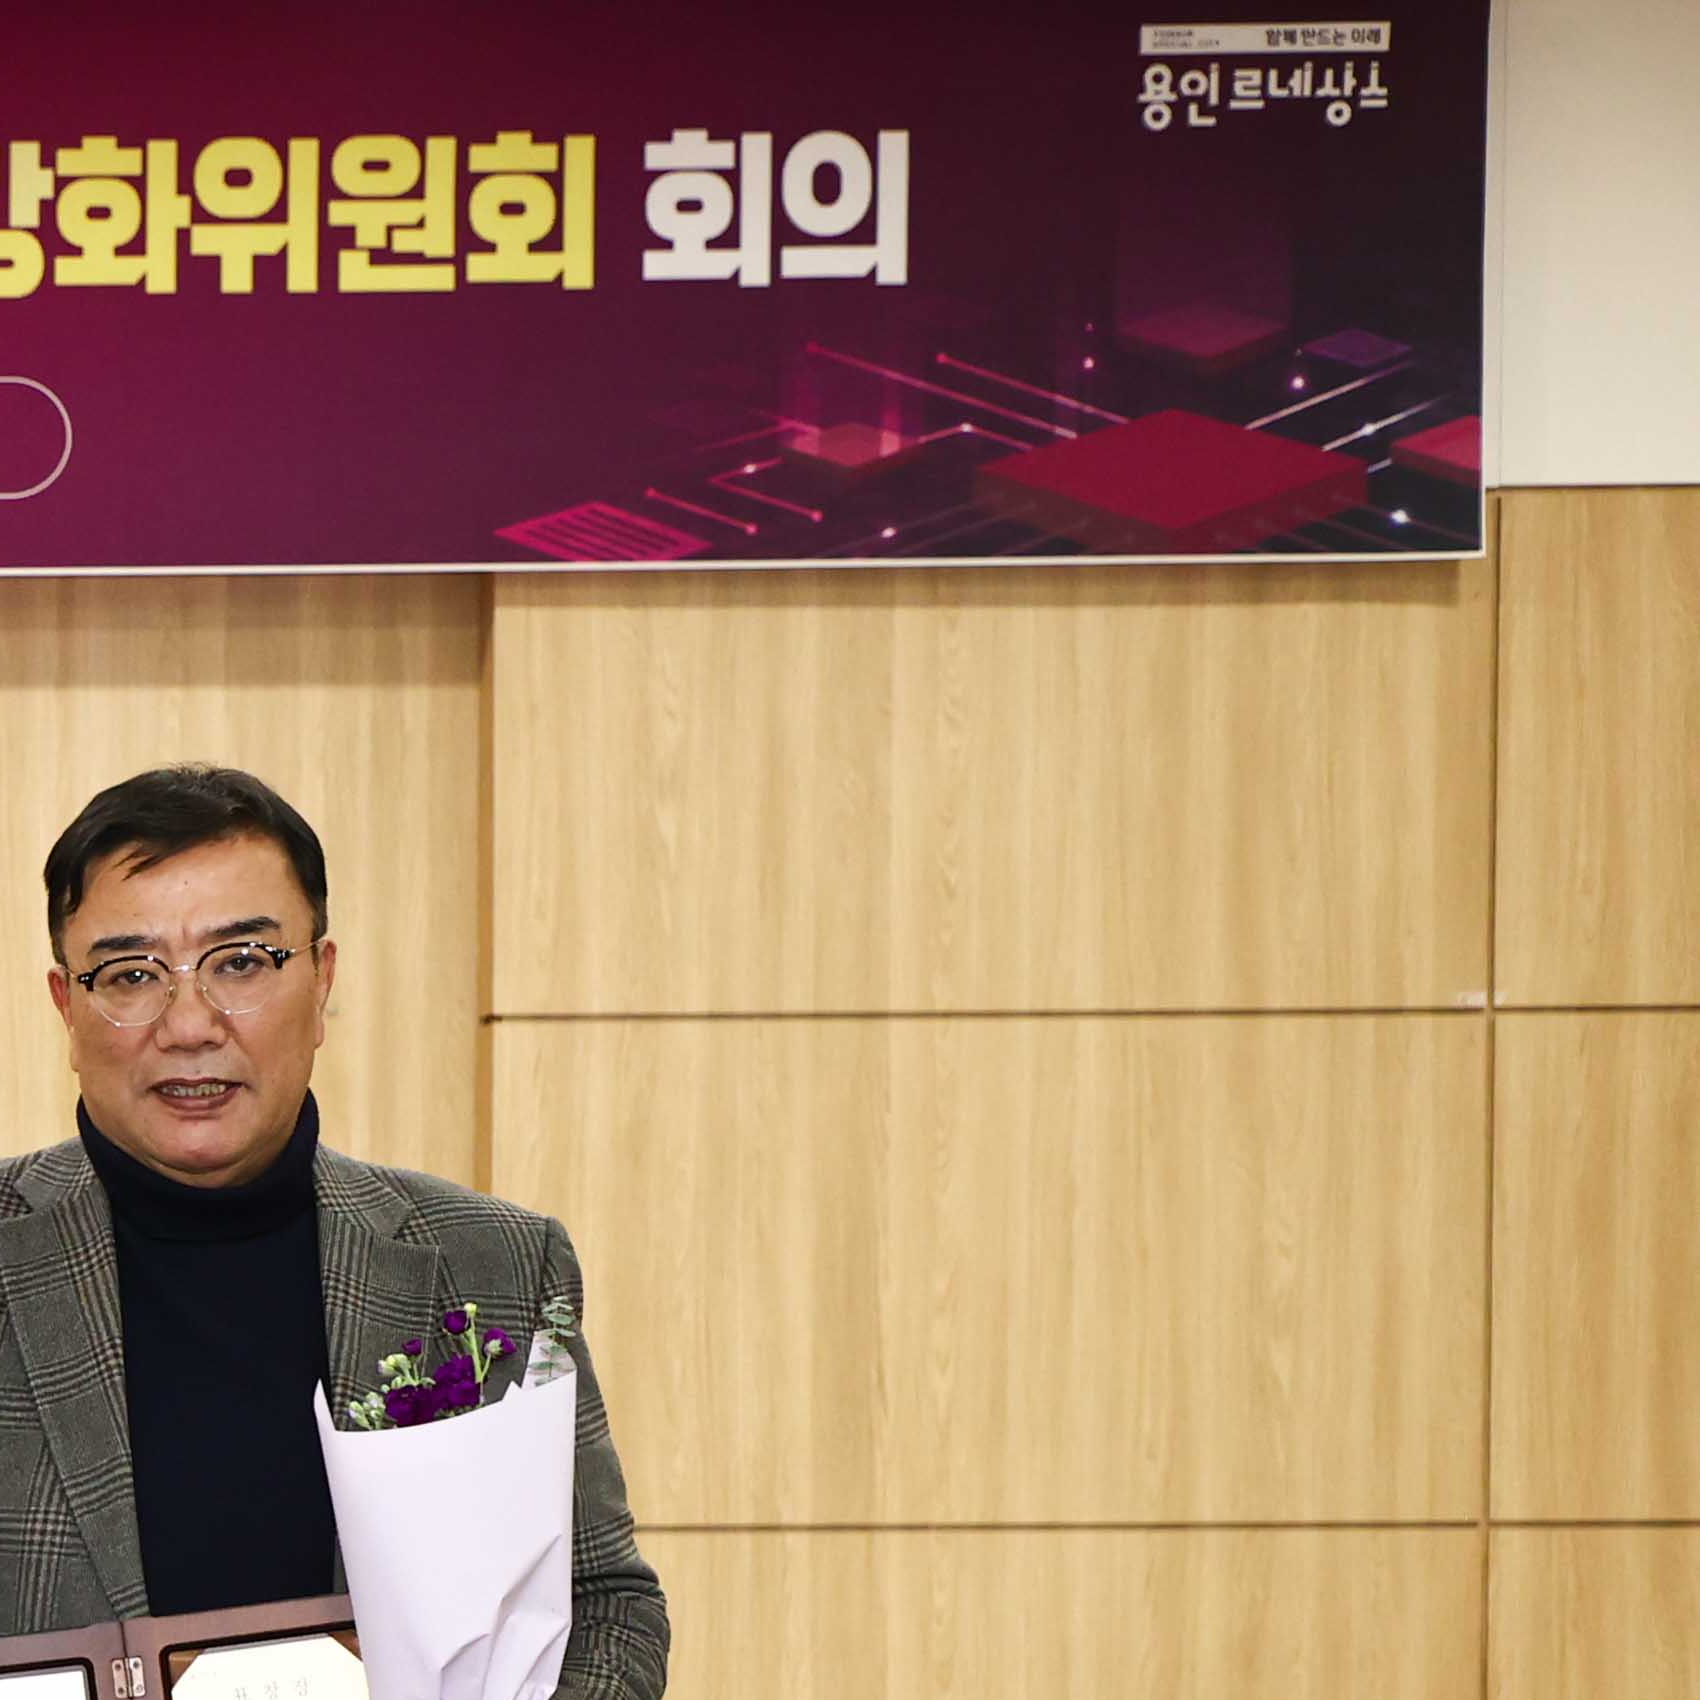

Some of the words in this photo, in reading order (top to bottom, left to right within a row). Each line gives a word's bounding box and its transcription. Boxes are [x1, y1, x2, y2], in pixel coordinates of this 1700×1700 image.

[1137, 62, 1219, 131] 용인
[1229, 61, 1388, 126] 르네상스
[642, 130, 909, 287] 회의
